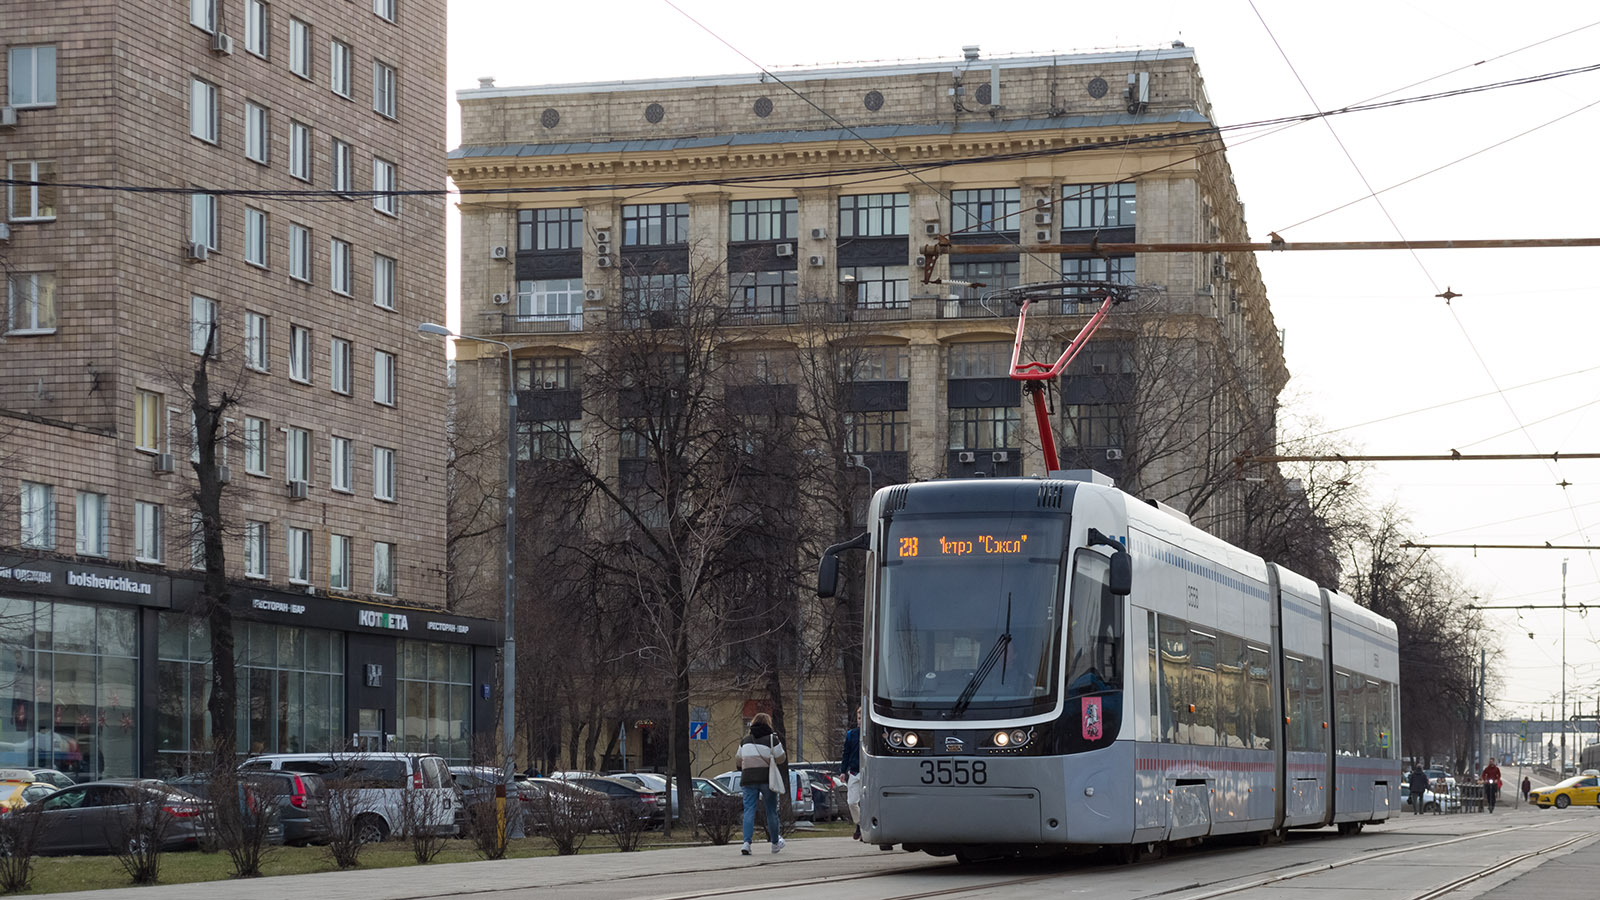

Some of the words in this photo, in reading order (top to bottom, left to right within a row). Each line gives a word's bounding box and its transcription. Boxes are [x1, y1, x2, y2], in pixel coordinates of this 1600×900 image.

[68, 571, 151, 594] bolshevichka.ru
[359, 610, 408, 630] КОТЛЕТА
[920, 760, 987, 785] 3558
